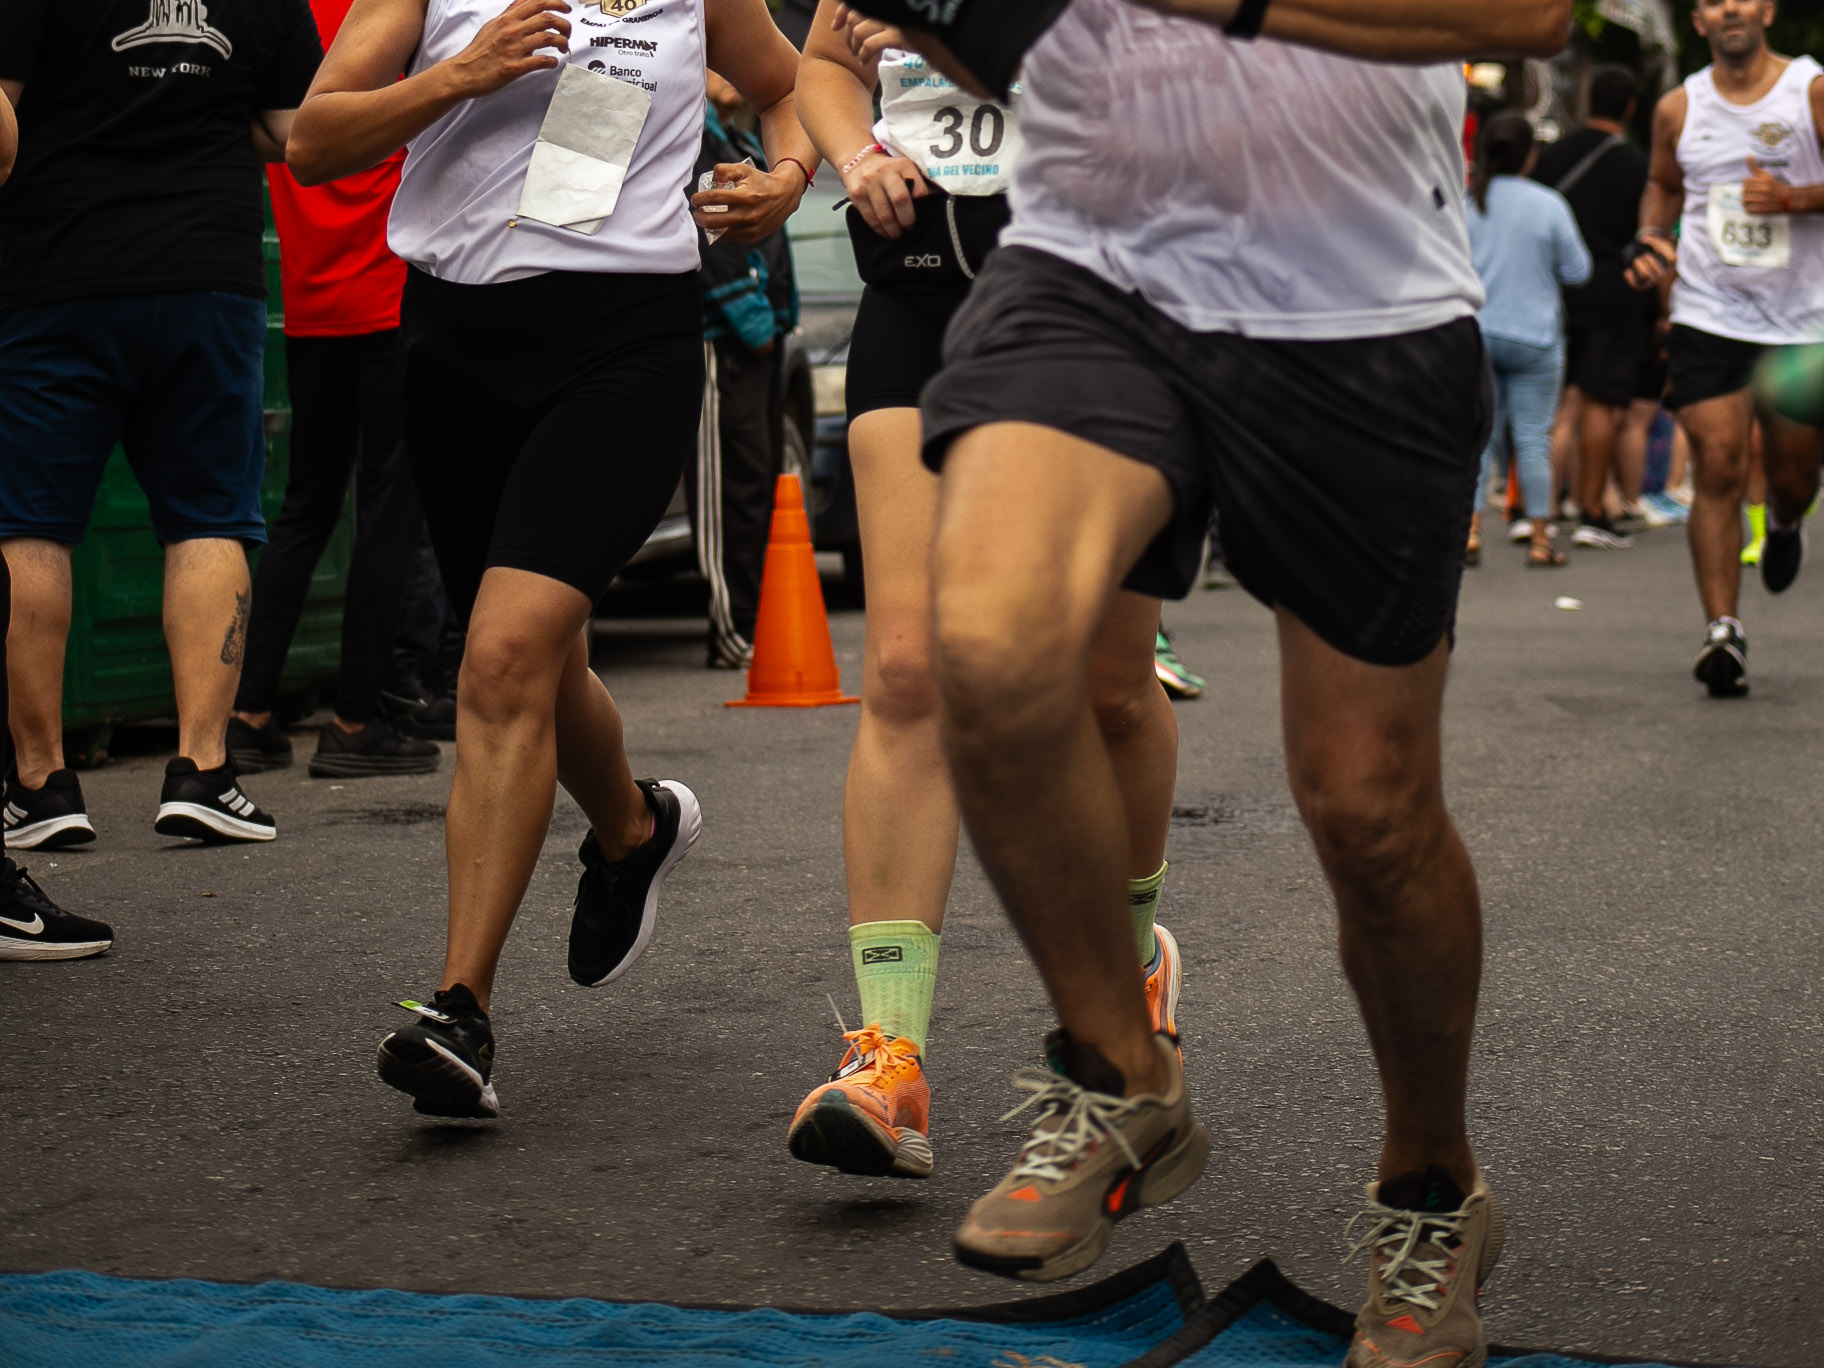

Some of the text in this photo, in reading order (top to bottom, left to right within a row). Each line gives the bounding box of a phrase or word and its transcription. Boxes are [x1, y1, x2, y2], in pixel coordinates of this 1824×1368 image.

[128, 66, 166, 78] NEW
[609, 65, 642, 77] Banco
[930, 103, 1005, 159] 30
[943, 164, 960, 177] DEL
[962, 163, 999, 176] VECINO
[1722, 220, 1772, 249] 633
[904, 254, 941, 268] EXO
